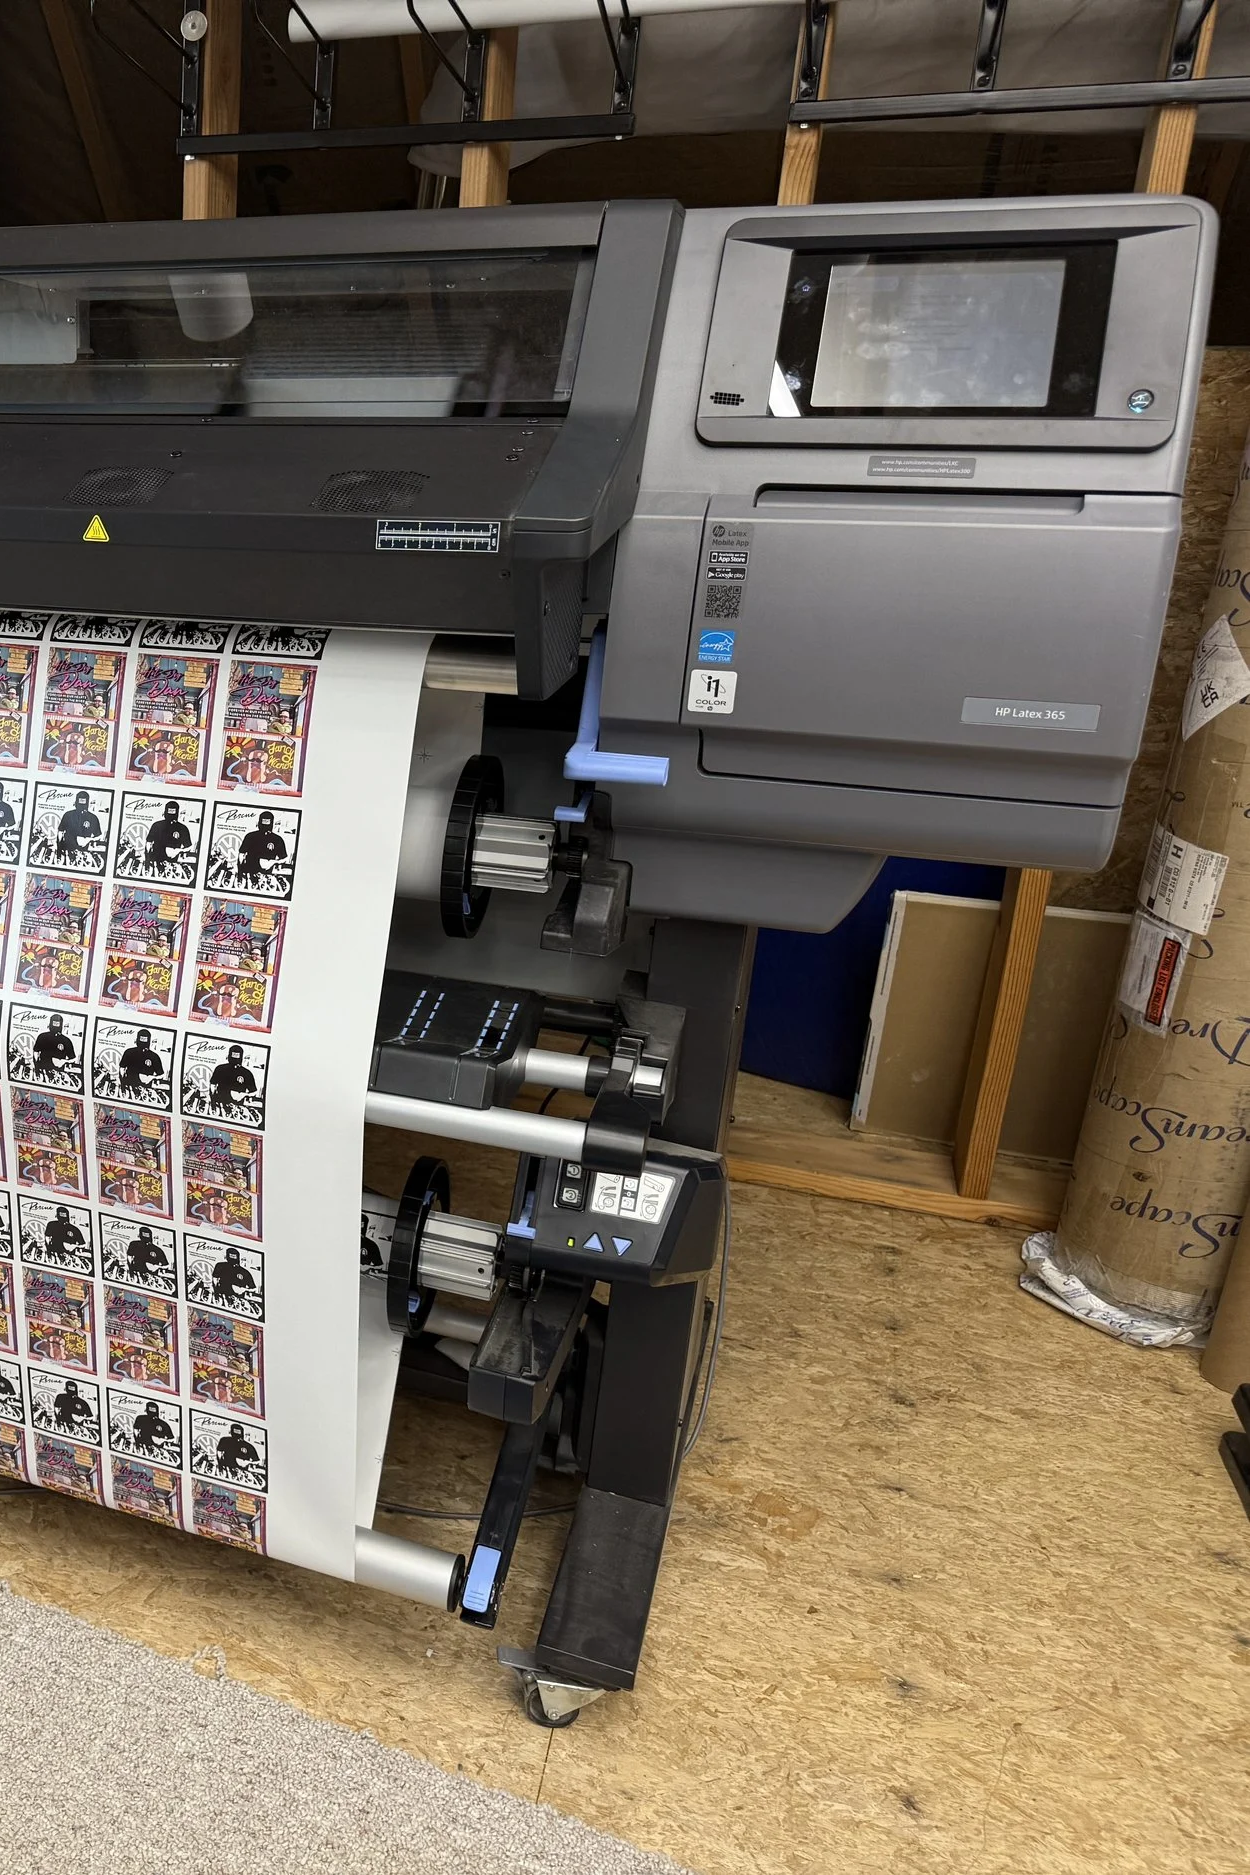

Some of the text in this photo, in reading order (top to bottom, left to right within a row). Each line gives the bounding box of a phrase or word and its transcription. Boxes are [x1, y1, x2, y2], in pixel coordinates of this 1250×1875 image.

[712, 525, 725, 537] hp
[47, 671, 97, 691] Dan
[136, 677, 188, 698] Dan
[229, 684, 283, 706] Dan
[995, 707, 1066, 720] HP Latex 365
[37, 789, 73, 803] Rescue
[124, 799, 162, 813] Rescue
[217, 809, 257, 822] Rescue
[1172, 845, 1183, 858] H
[1173, 868, 1179, 876] CO
[24, 896, 72, 916] Dan
[110, 908, 161, 928] Dan
[201, 920, 254, 941] Dan
[1162, 942, 1176, 971] PACKING
[1158, 972, 1168, 987] LIST
[13, 1010, 48, 1022] Rescue
[99, 1025, 135, 1037] Rescue
[189, 1041, 227, 1053] Rescue
[20, 1202, 54, 1212] Rescue
[102, 1221, 137, 1230] Rescue
[187, 1242, 223, 1252] Rescue
[31, 1375, 63, 1384] Rescue
[110, 1395, 143, 1404] Rescue
[193, 1418, 228, 1427] Rescue
